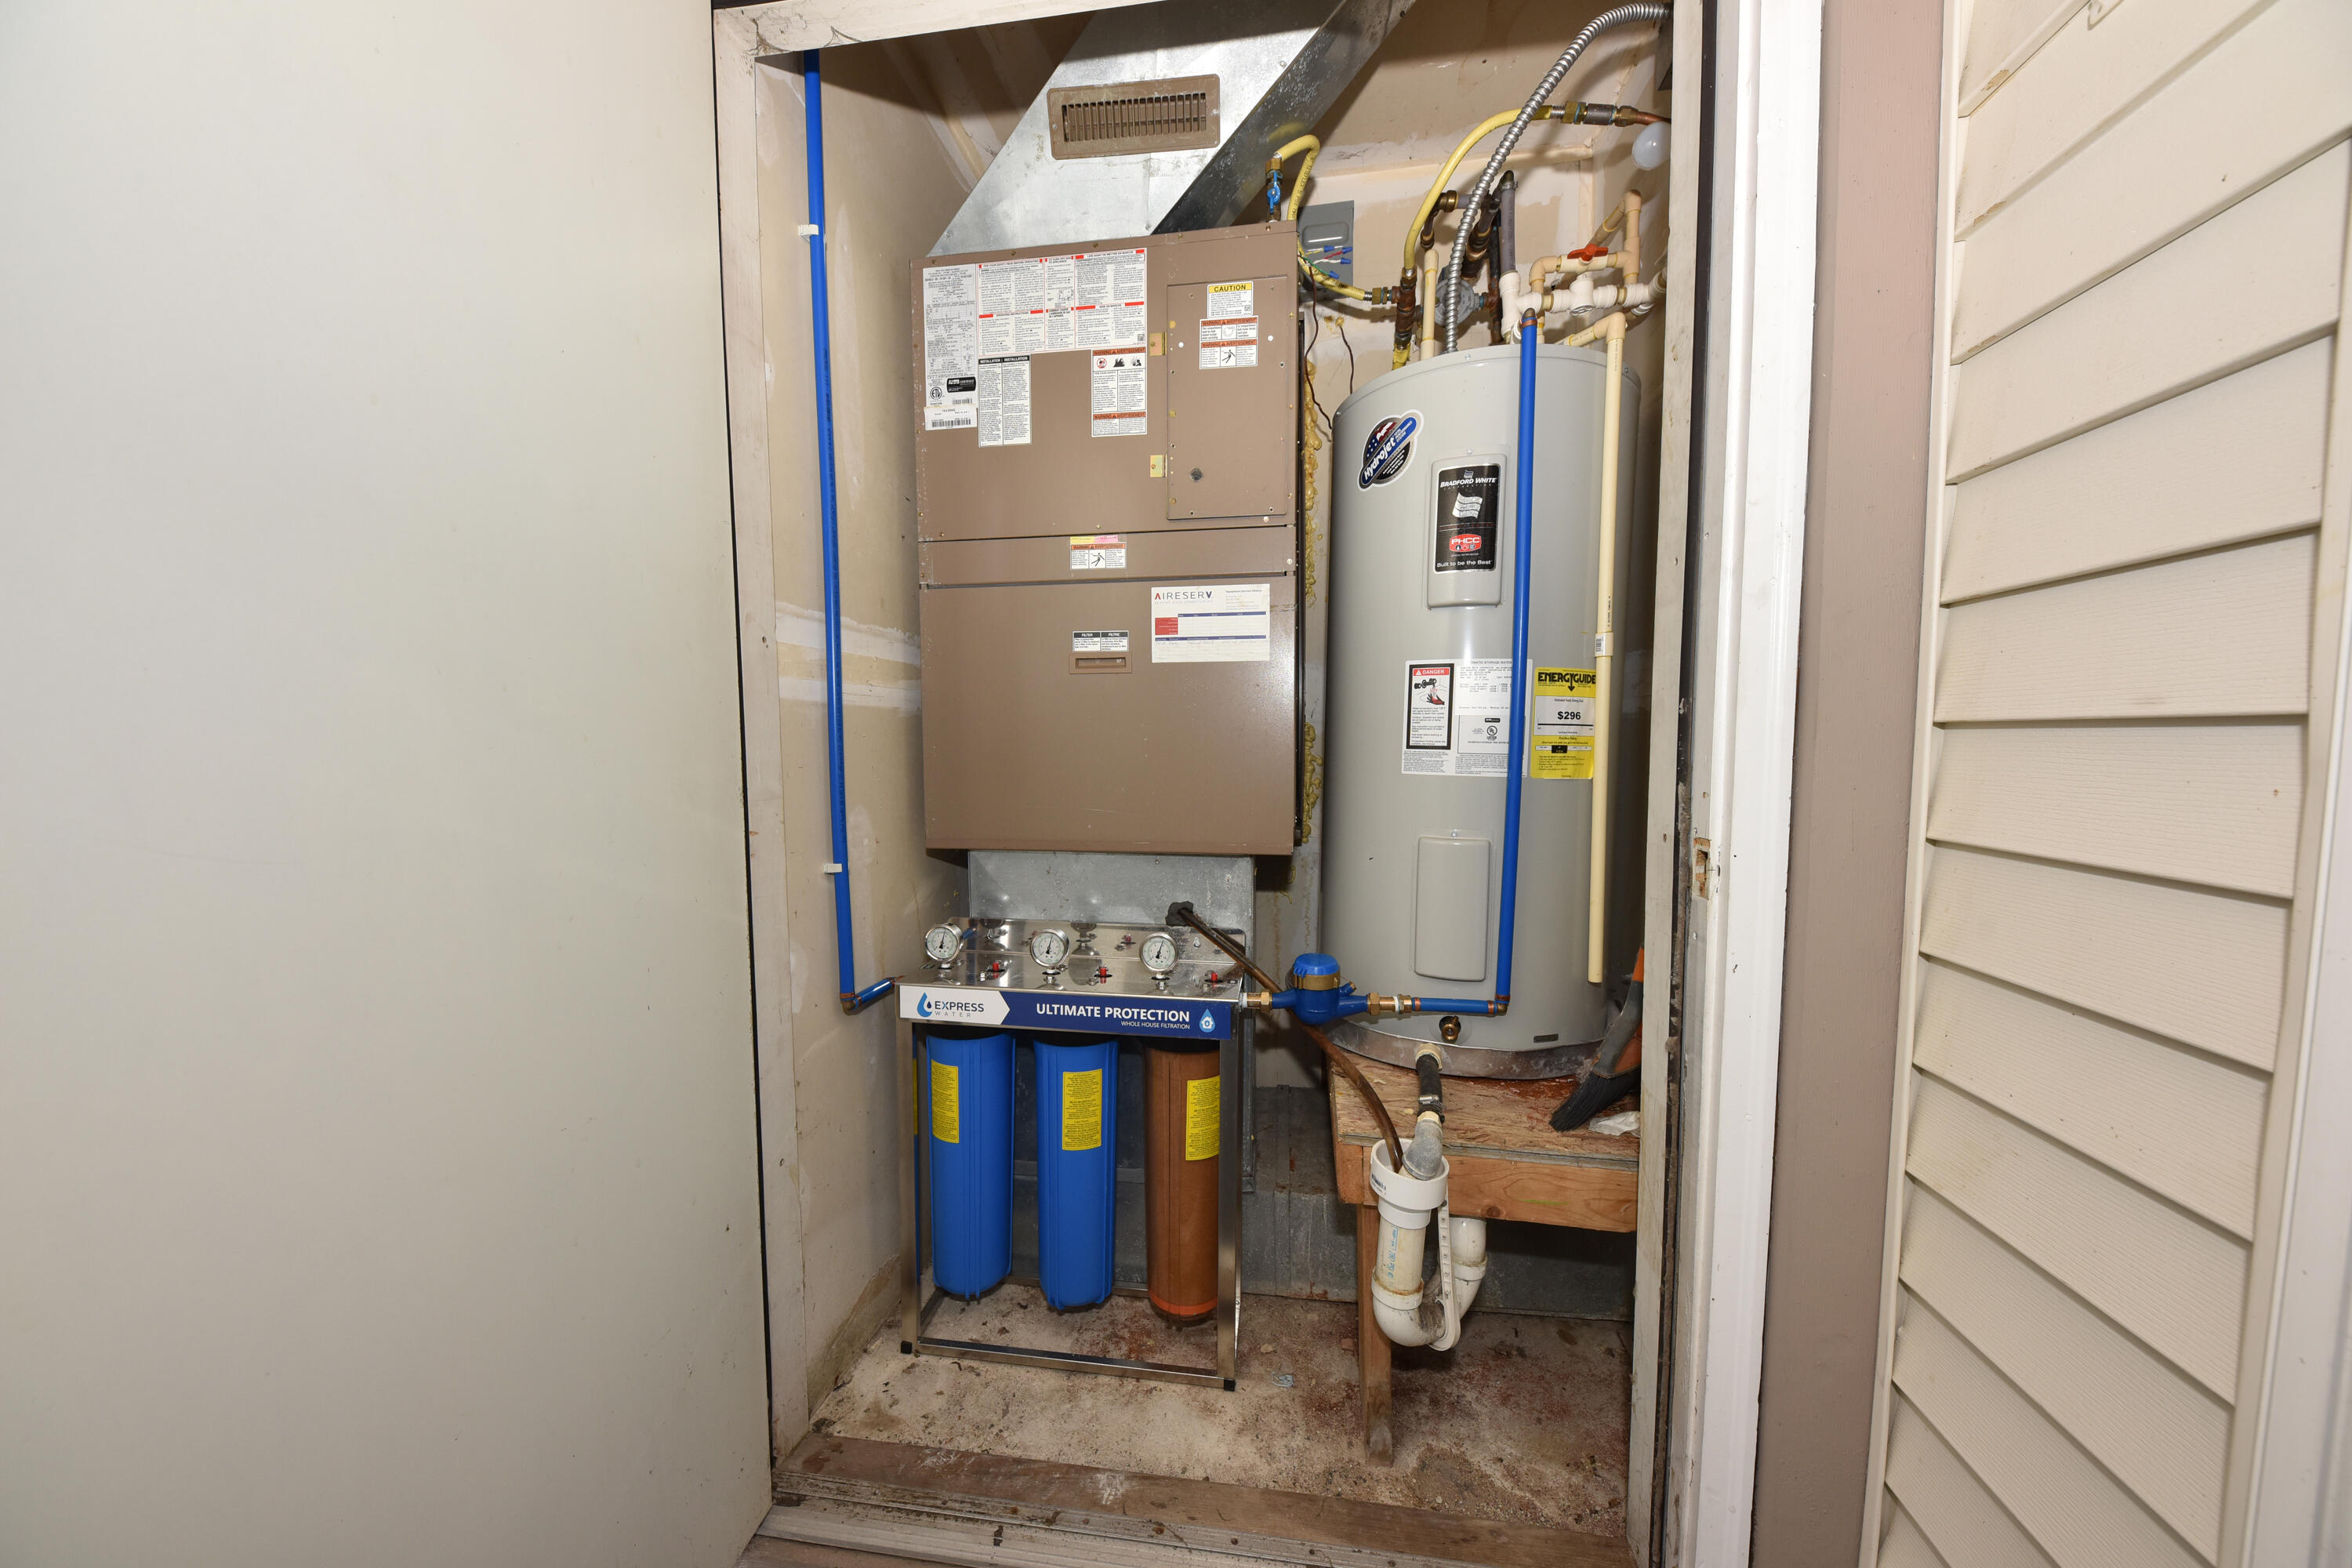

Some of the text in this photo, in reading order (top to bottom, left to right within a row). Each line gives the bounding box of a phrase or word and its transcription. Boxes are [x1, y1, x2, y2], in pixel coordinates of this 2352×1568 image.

[1364, 437, 1396, 480] Hydrojet
[1440, 478, 1474, 488] BRADFORD
[1537, 672, 1596, 685] ENERGYGUIDE
[1557, 711, 1581, 720] $296
[935, 1000, 985, 1012] EXPRESS
[1036, 1003, 1190, 1022] ULTIMATE PROTECTION
